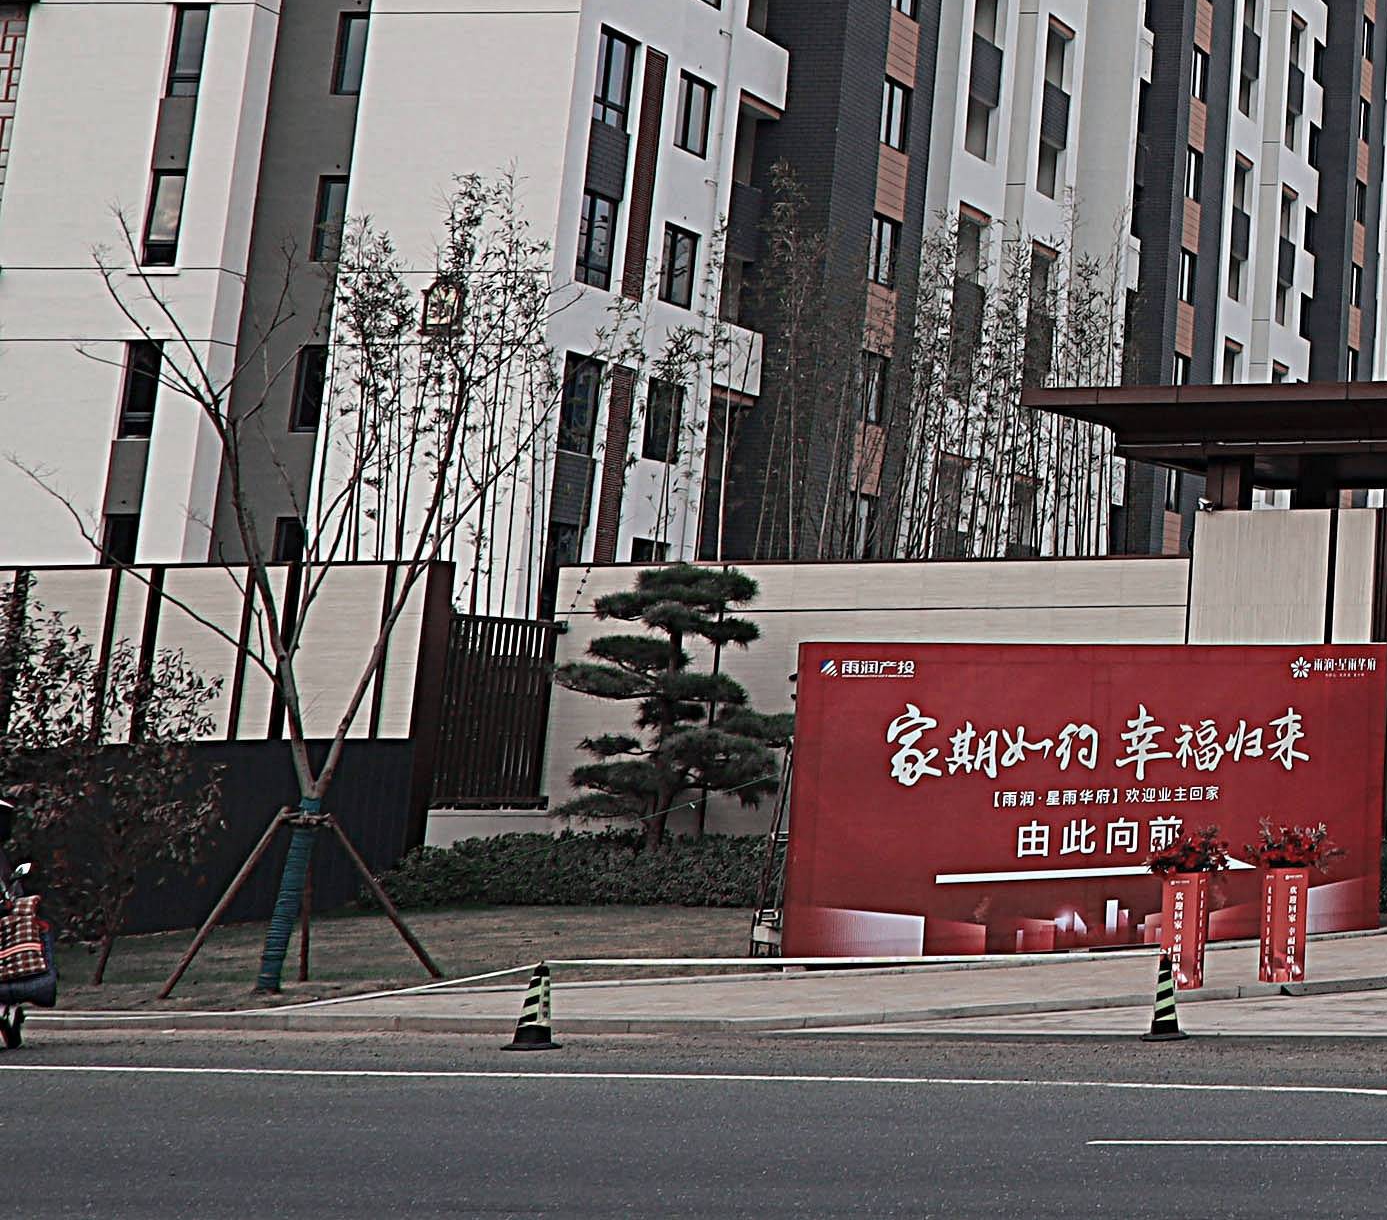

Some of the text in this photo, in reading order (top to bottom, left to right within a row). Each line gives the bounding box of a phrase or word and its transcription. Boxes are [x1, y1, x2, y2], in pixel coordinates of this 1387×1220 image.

[841, 660, 915, 674] 雨润产投
[887, 703, 1310, 786] 家期如约 幸福归来
[1016, 815, 1183, 858] 由此向前
